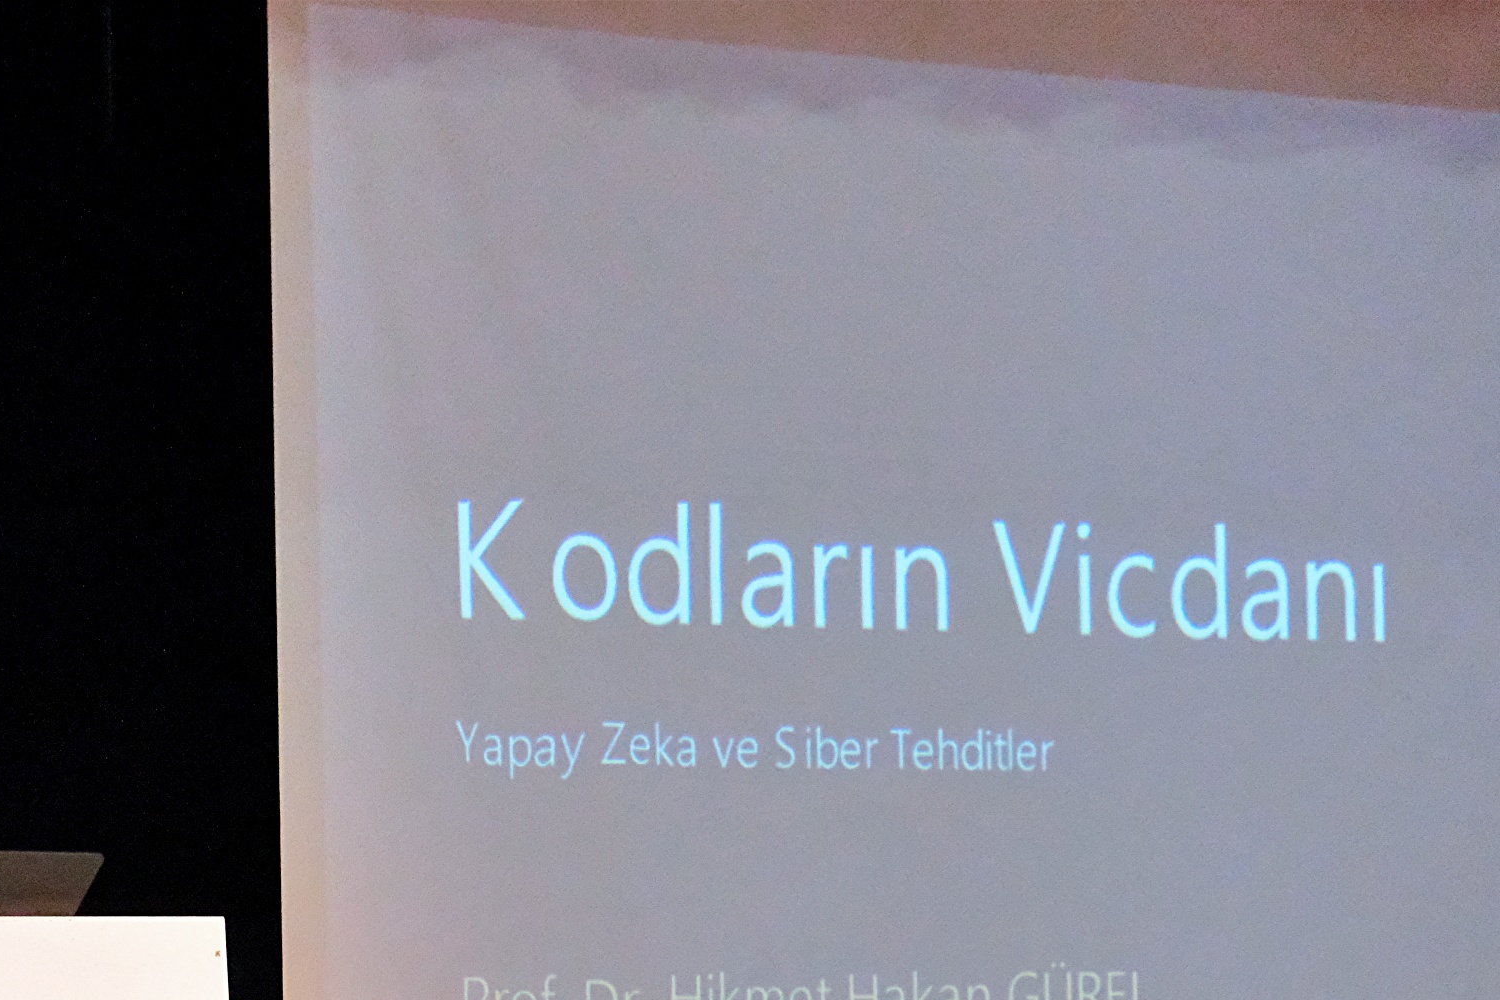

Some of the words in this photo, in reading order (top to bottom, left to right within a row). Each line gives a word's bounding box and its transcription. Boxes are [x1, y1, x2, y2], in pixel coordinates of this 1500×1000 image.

[457, 498, 951, 633] Kodların
[993, 520, 1388, 645] Vicdanı
[456, 720, 587, 780] Yapay
[601, 721, 699, 768] Zeka
[713, 737, 761, 771] ve
[774, 726, 881, 772] Siber
[890, 728, 1056, 773] Tehditler
